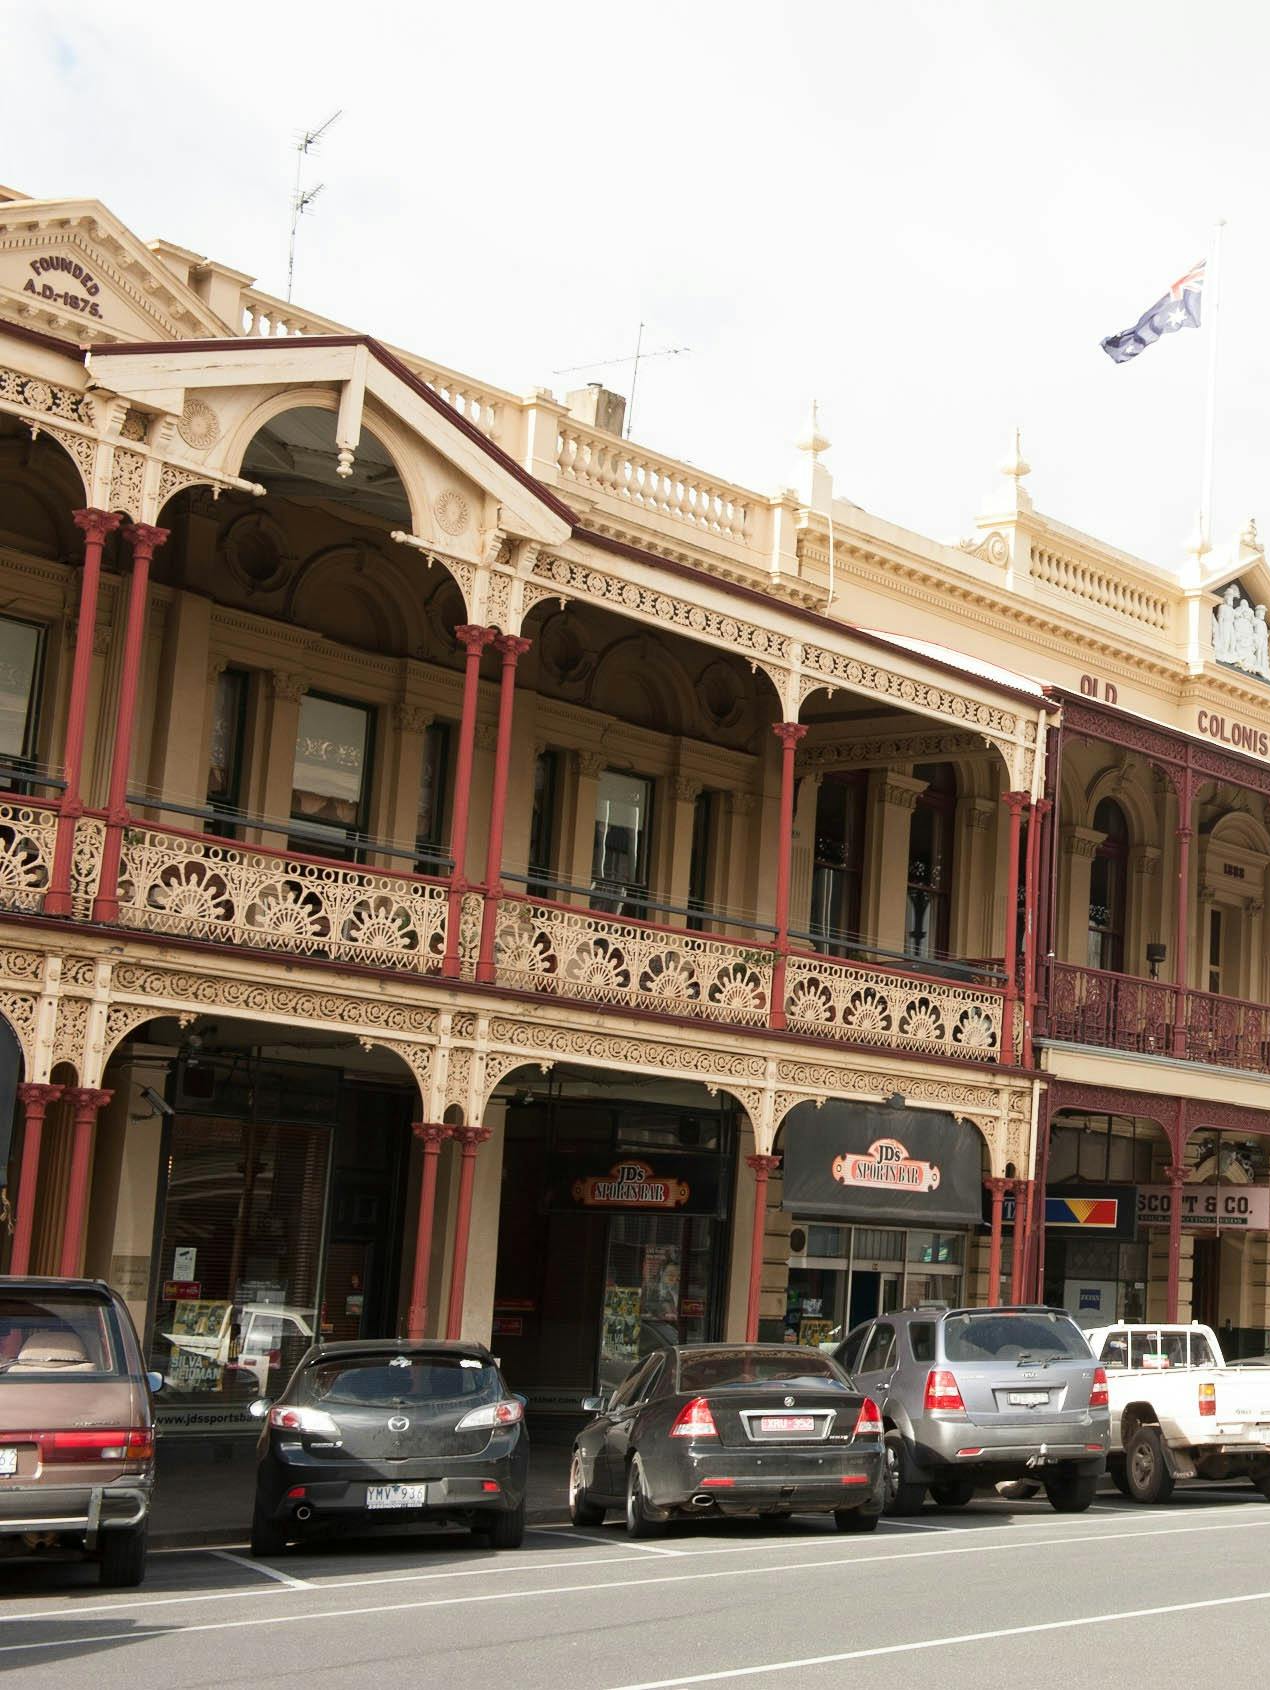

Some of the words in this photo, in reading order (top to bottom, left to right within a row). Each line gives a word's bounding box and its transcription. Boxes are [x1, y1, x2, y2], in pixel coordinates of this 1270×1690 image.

[30, 256, 100, 297] FOUNDED
[877, 1145, 901, 1164] JD's
[617, 1165, 645, 1184] JD's
[857, 1162, 896, 1182] SPORTS
[898, 1166, 920, 1184] BAR
[595, 1183, 639, 1201] SPORTS
[640, 1184, 665, 1202] BAR
[1138, 1194, 1198, 1213] SCOT
[1206, 1197, 1217, 1213] &
[1225, 1197, 1253, 1214] CO.
[170, 1355, 203, 1369] SILVA
[368, 1487, 392, 1501] YMV
[401, 1486, 424, 1500] 936
